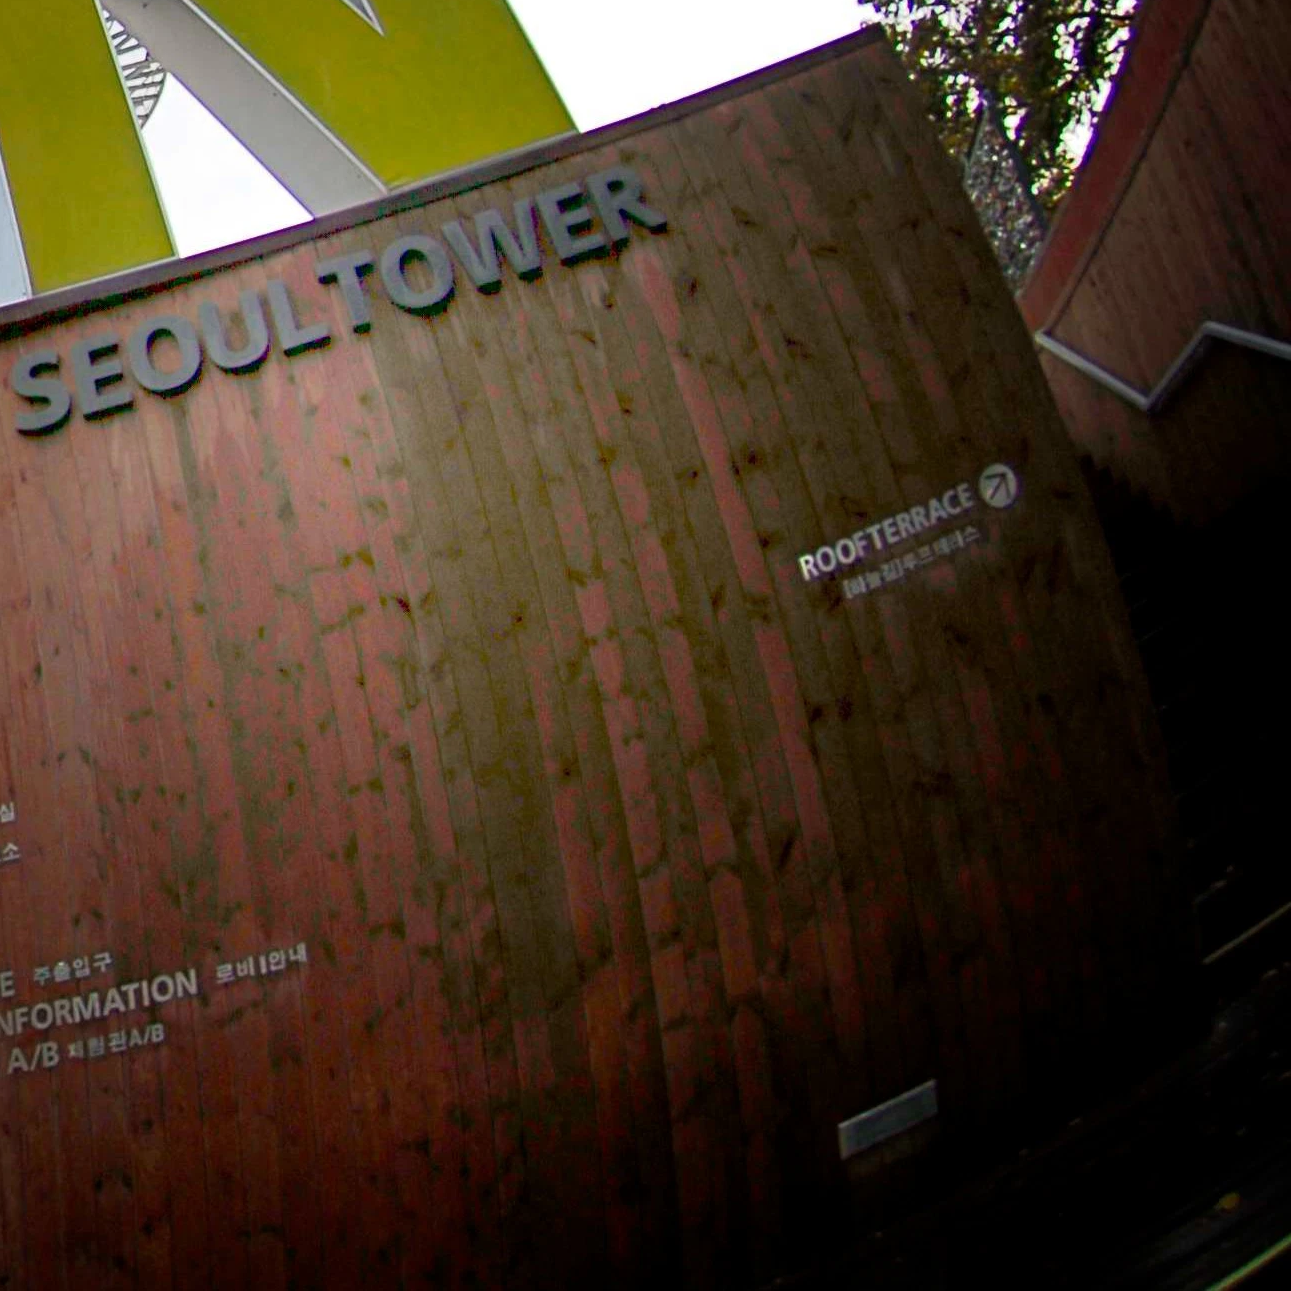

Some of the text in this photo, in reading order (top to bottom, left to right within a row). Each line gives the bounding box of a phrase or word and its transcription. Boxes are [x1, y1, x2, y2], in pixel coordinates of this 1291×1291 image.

[10, 167, 669, 436] SEOUL TOWER
[799, 483, 975, 581] ROOFTERRACE
[7, 1040, 60, 1076] A/B
